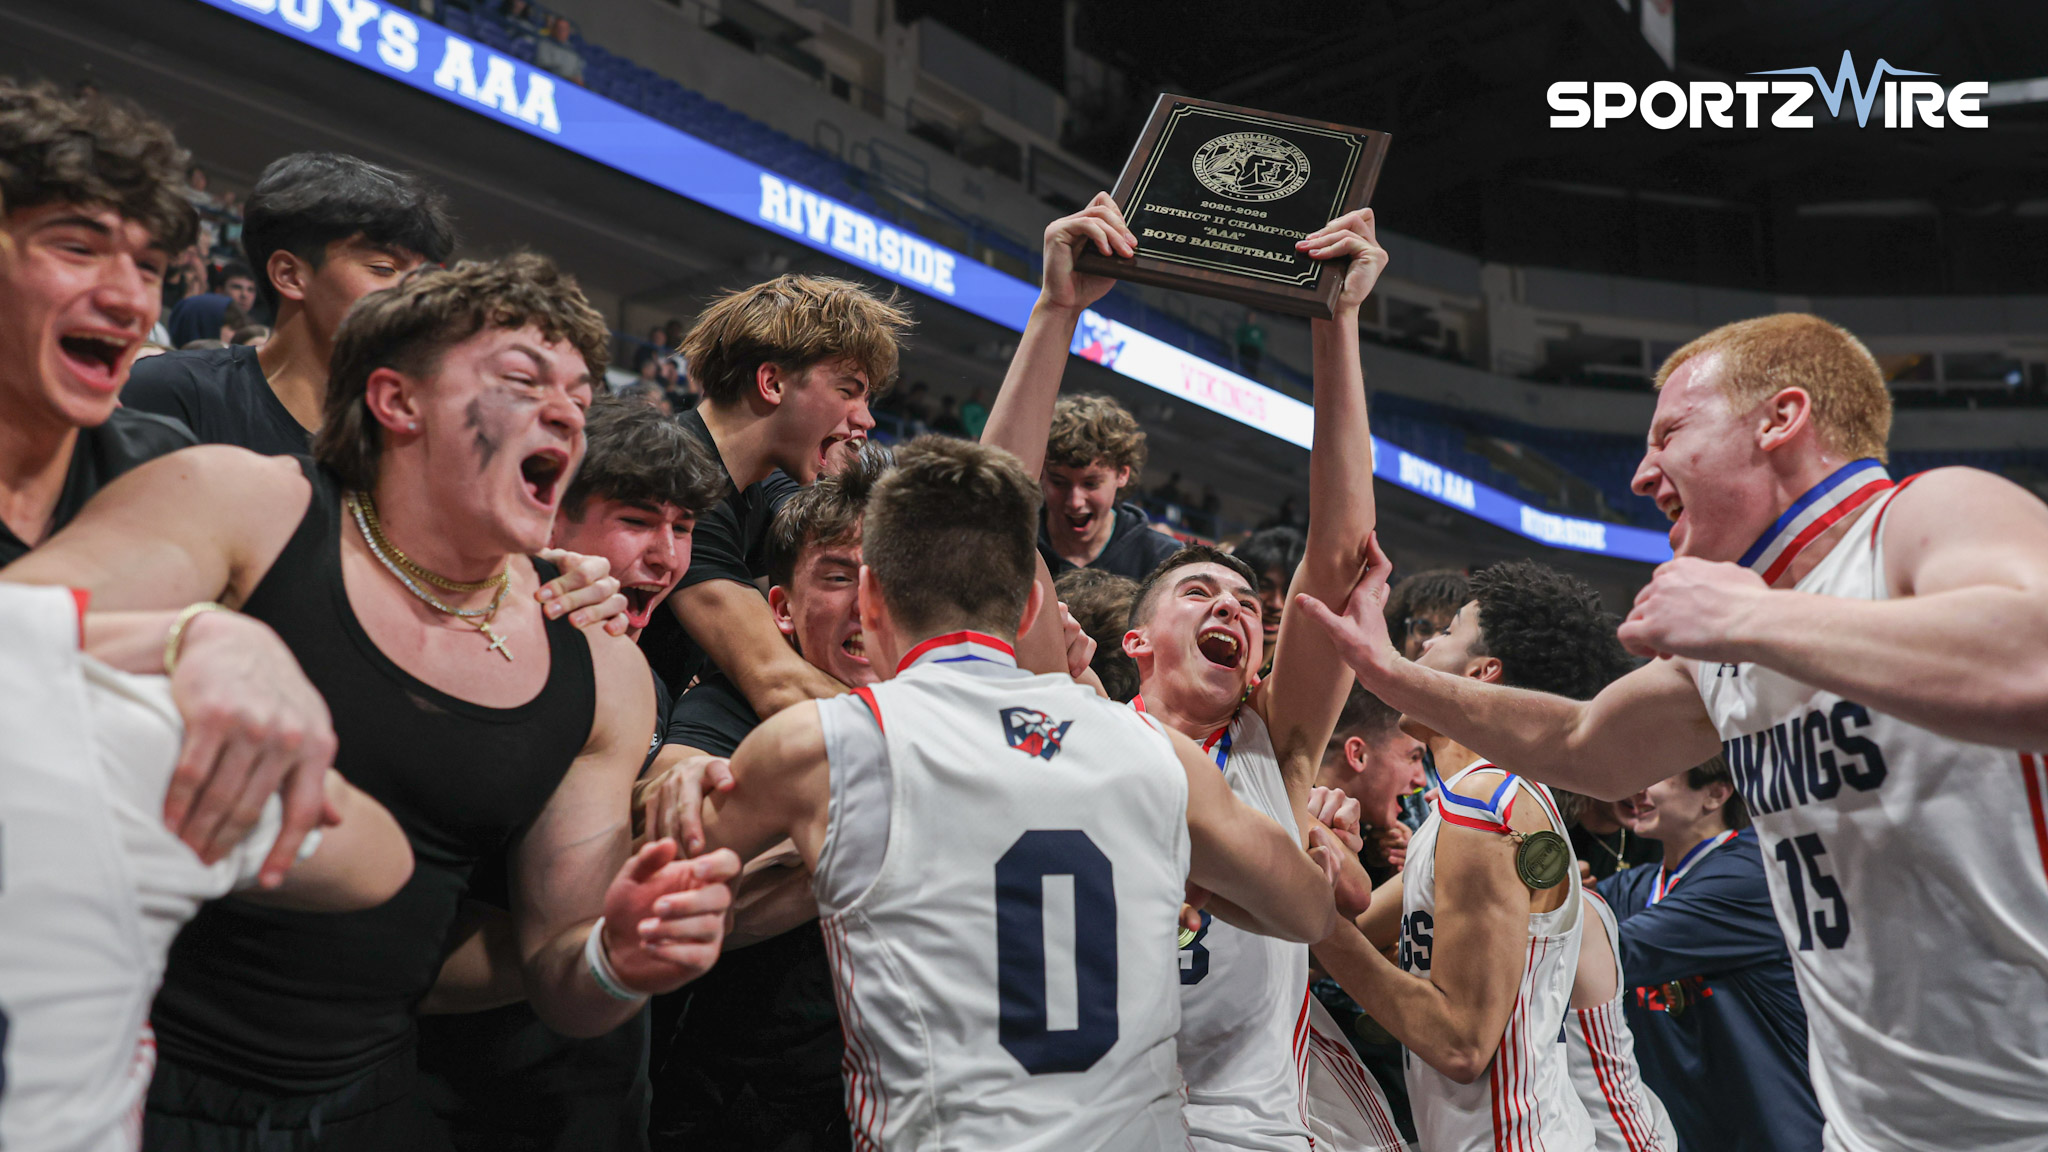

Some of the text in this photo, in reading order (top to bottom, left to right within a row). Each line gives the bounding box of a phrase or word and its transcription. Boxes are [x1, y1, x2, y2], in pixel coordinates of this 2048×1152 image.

[434, 35, 562, 134] AAA
[759, 171, 956, 297] RIVERSIDE
[1142, 228, 1295, 265] BOYS BASKETBALL
[1144, 203, 1211, 222] DISTRICT
[1212, 214, 1225, 226] II
[1200, 200, 1268, 219] 2025-2026
[1775, 833, 1850, 951] 15
[995, 830, 1119, 1075] 0
